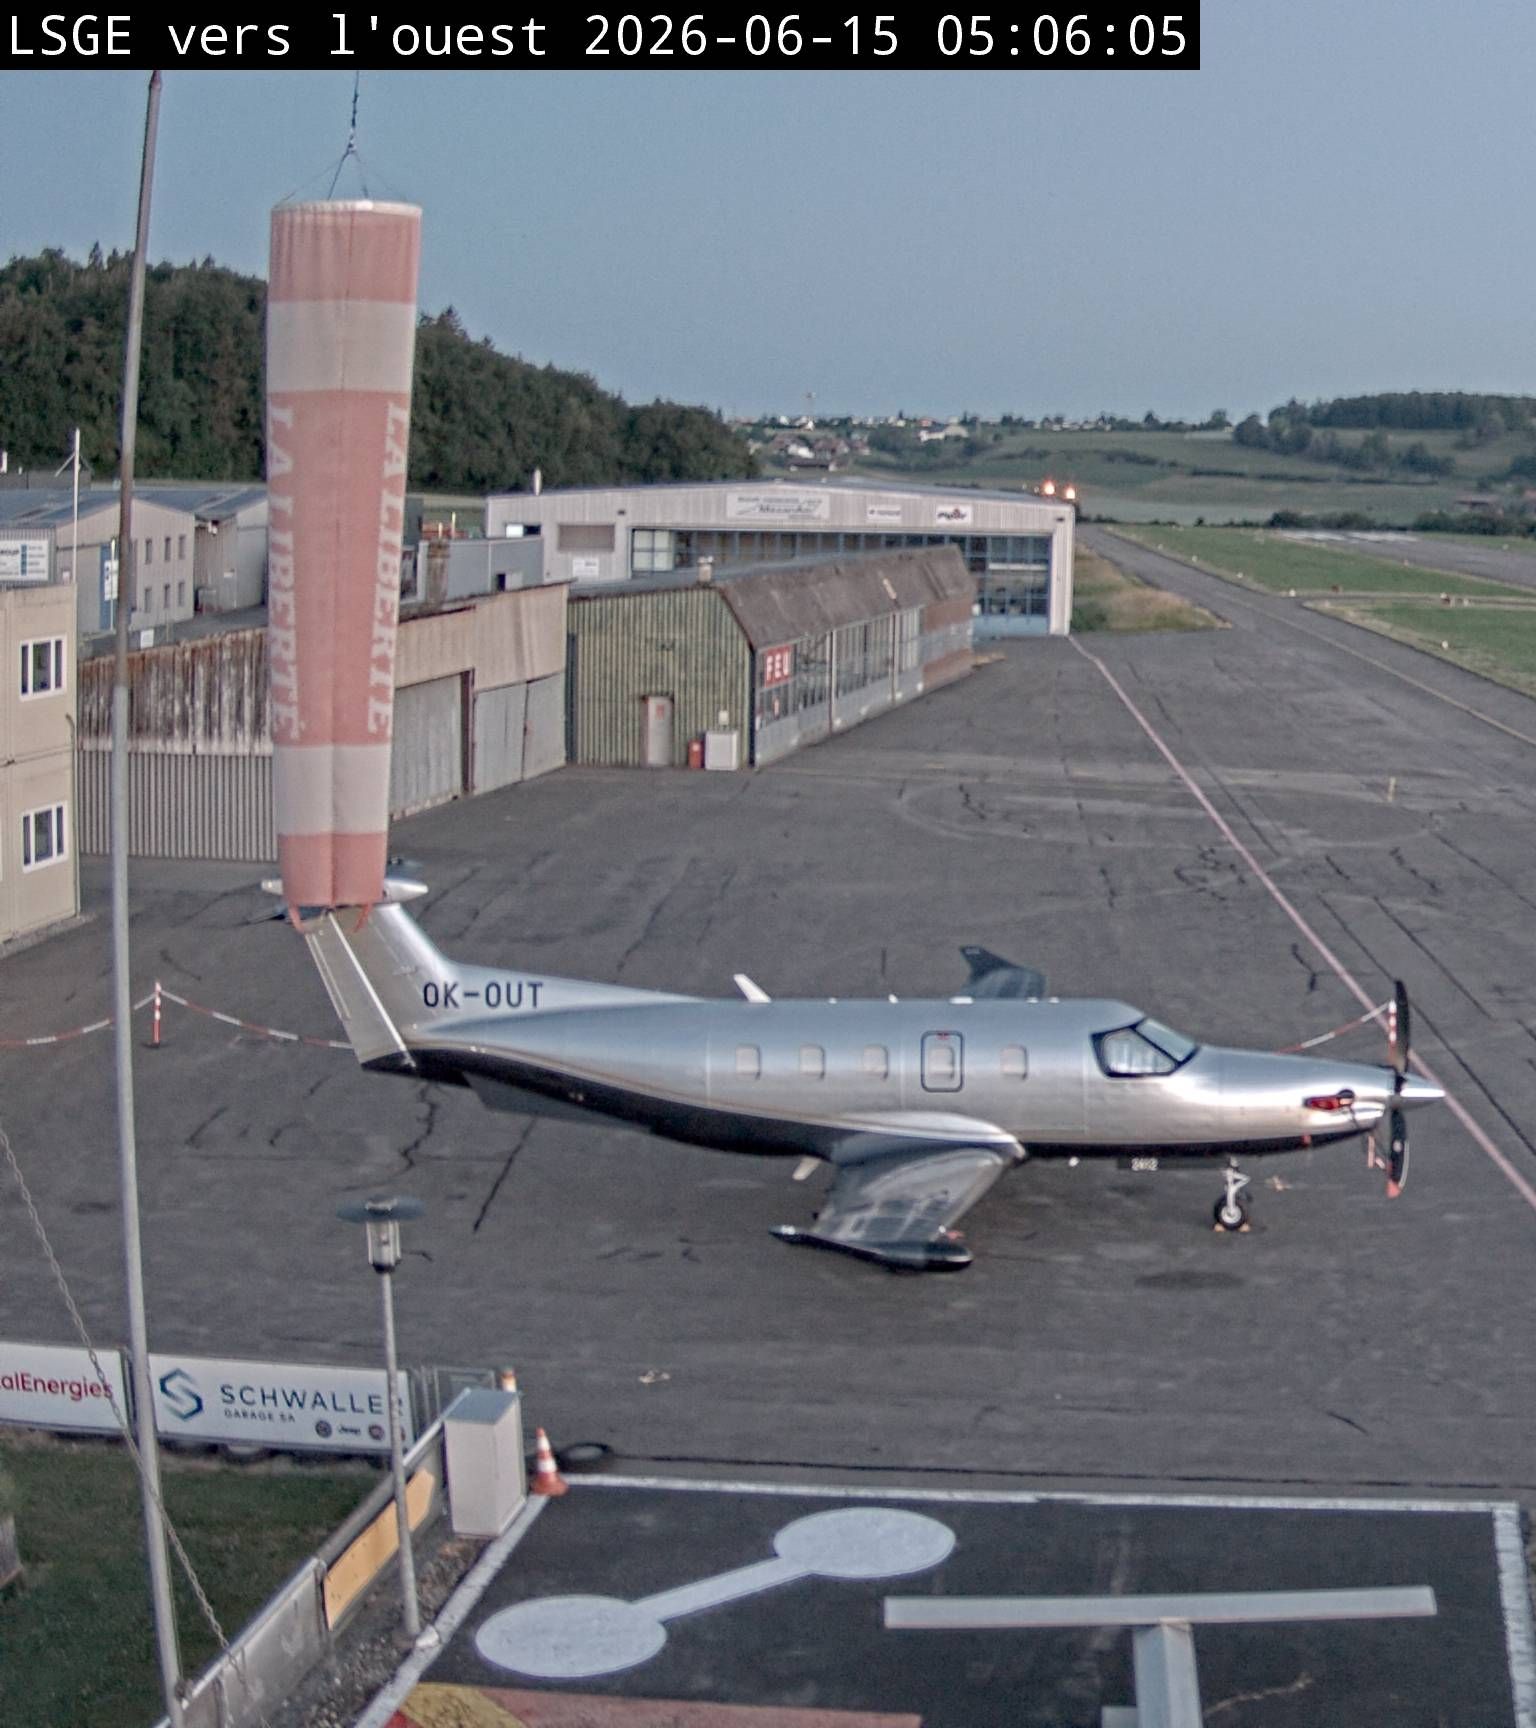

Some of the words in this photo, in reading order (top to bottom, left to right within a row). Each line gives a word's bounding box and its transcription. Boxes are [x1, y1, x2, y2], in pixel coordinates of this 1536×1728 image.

[766, 650, 790, 681] FEU
[422, 981, 544, 1009] OK-OUT
[0, 1370, 113, 1402] alEnergies
